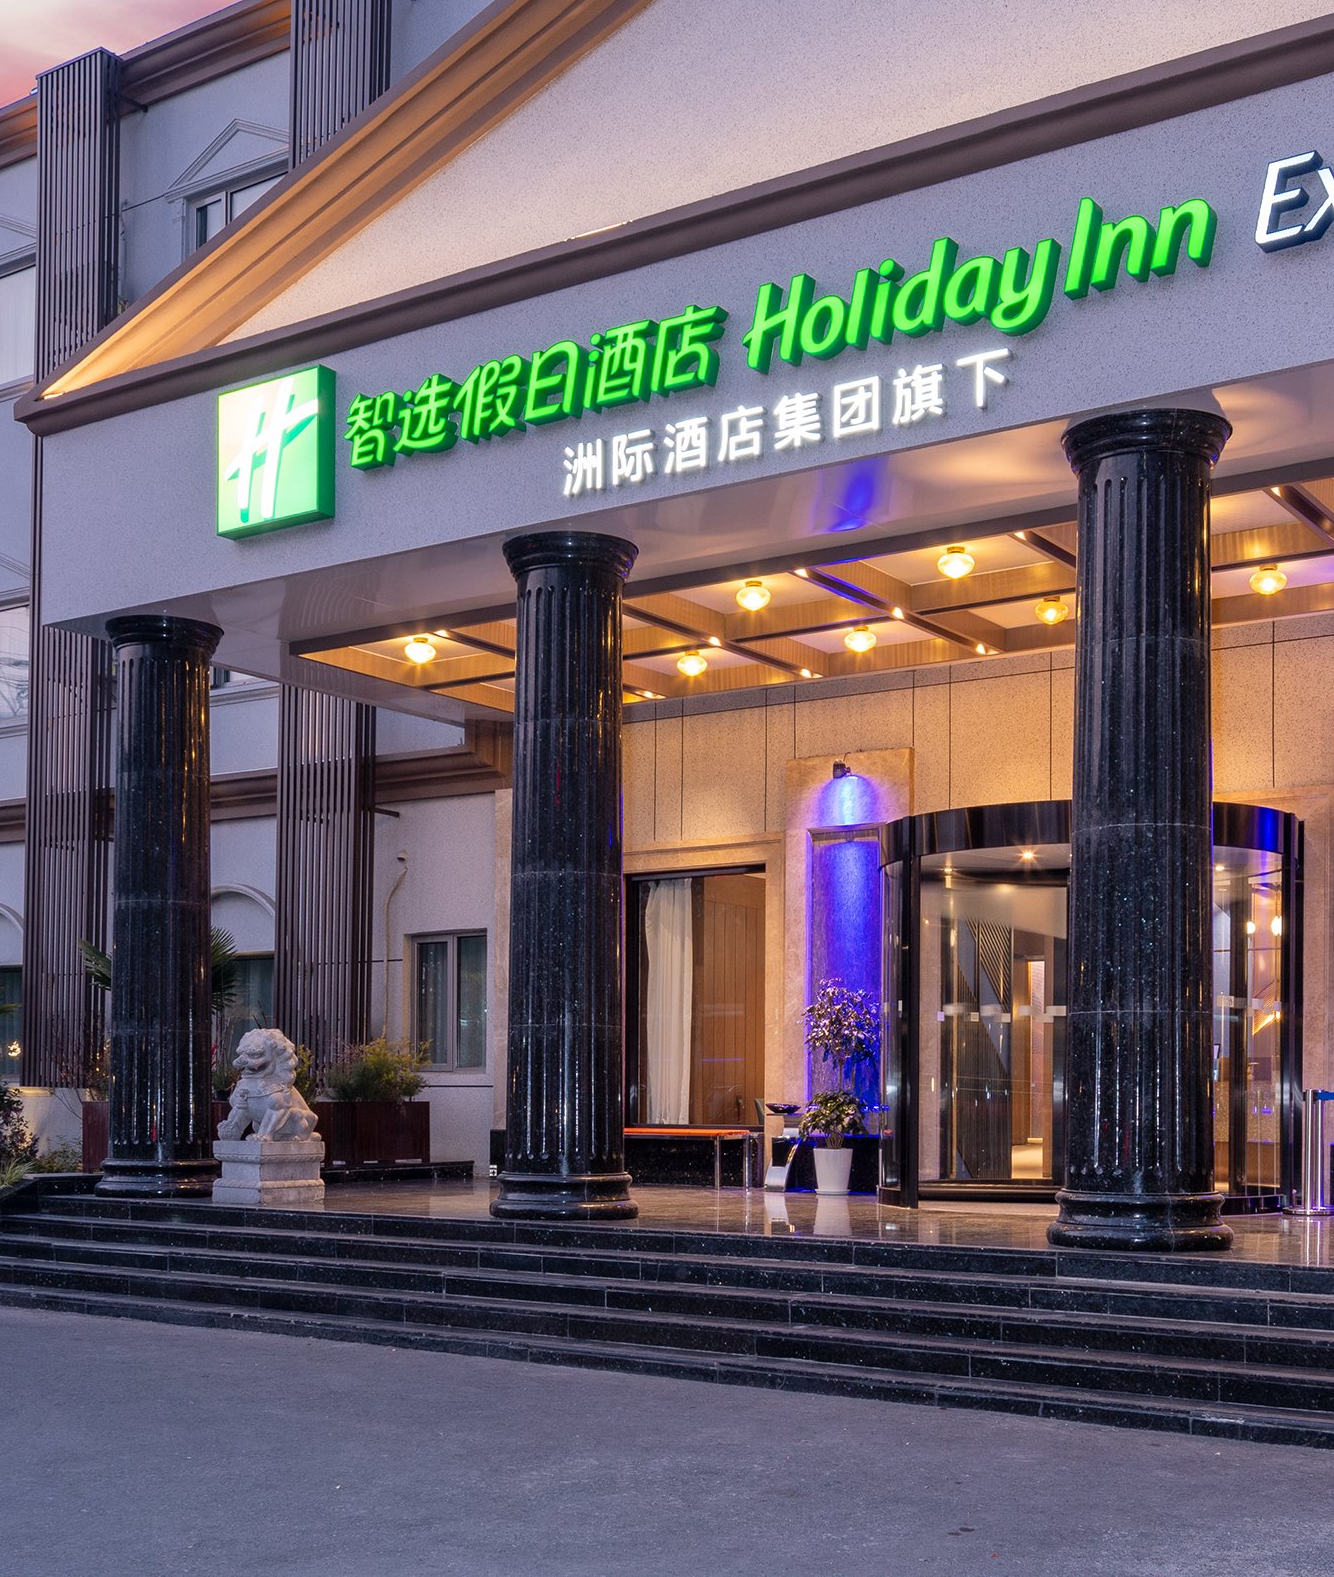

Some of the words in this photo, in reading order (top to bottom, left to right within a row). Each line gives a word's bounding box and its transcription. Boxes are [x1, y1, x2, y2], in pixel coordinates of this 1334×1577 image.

[742, 236, 1061, 375] Holiday
[1064, 197, 1217, 300] Inn
[343, 305, 726, 470] 智选假日酒店
[562, 347, 1012, 497] 洲际酒店集团旗下
